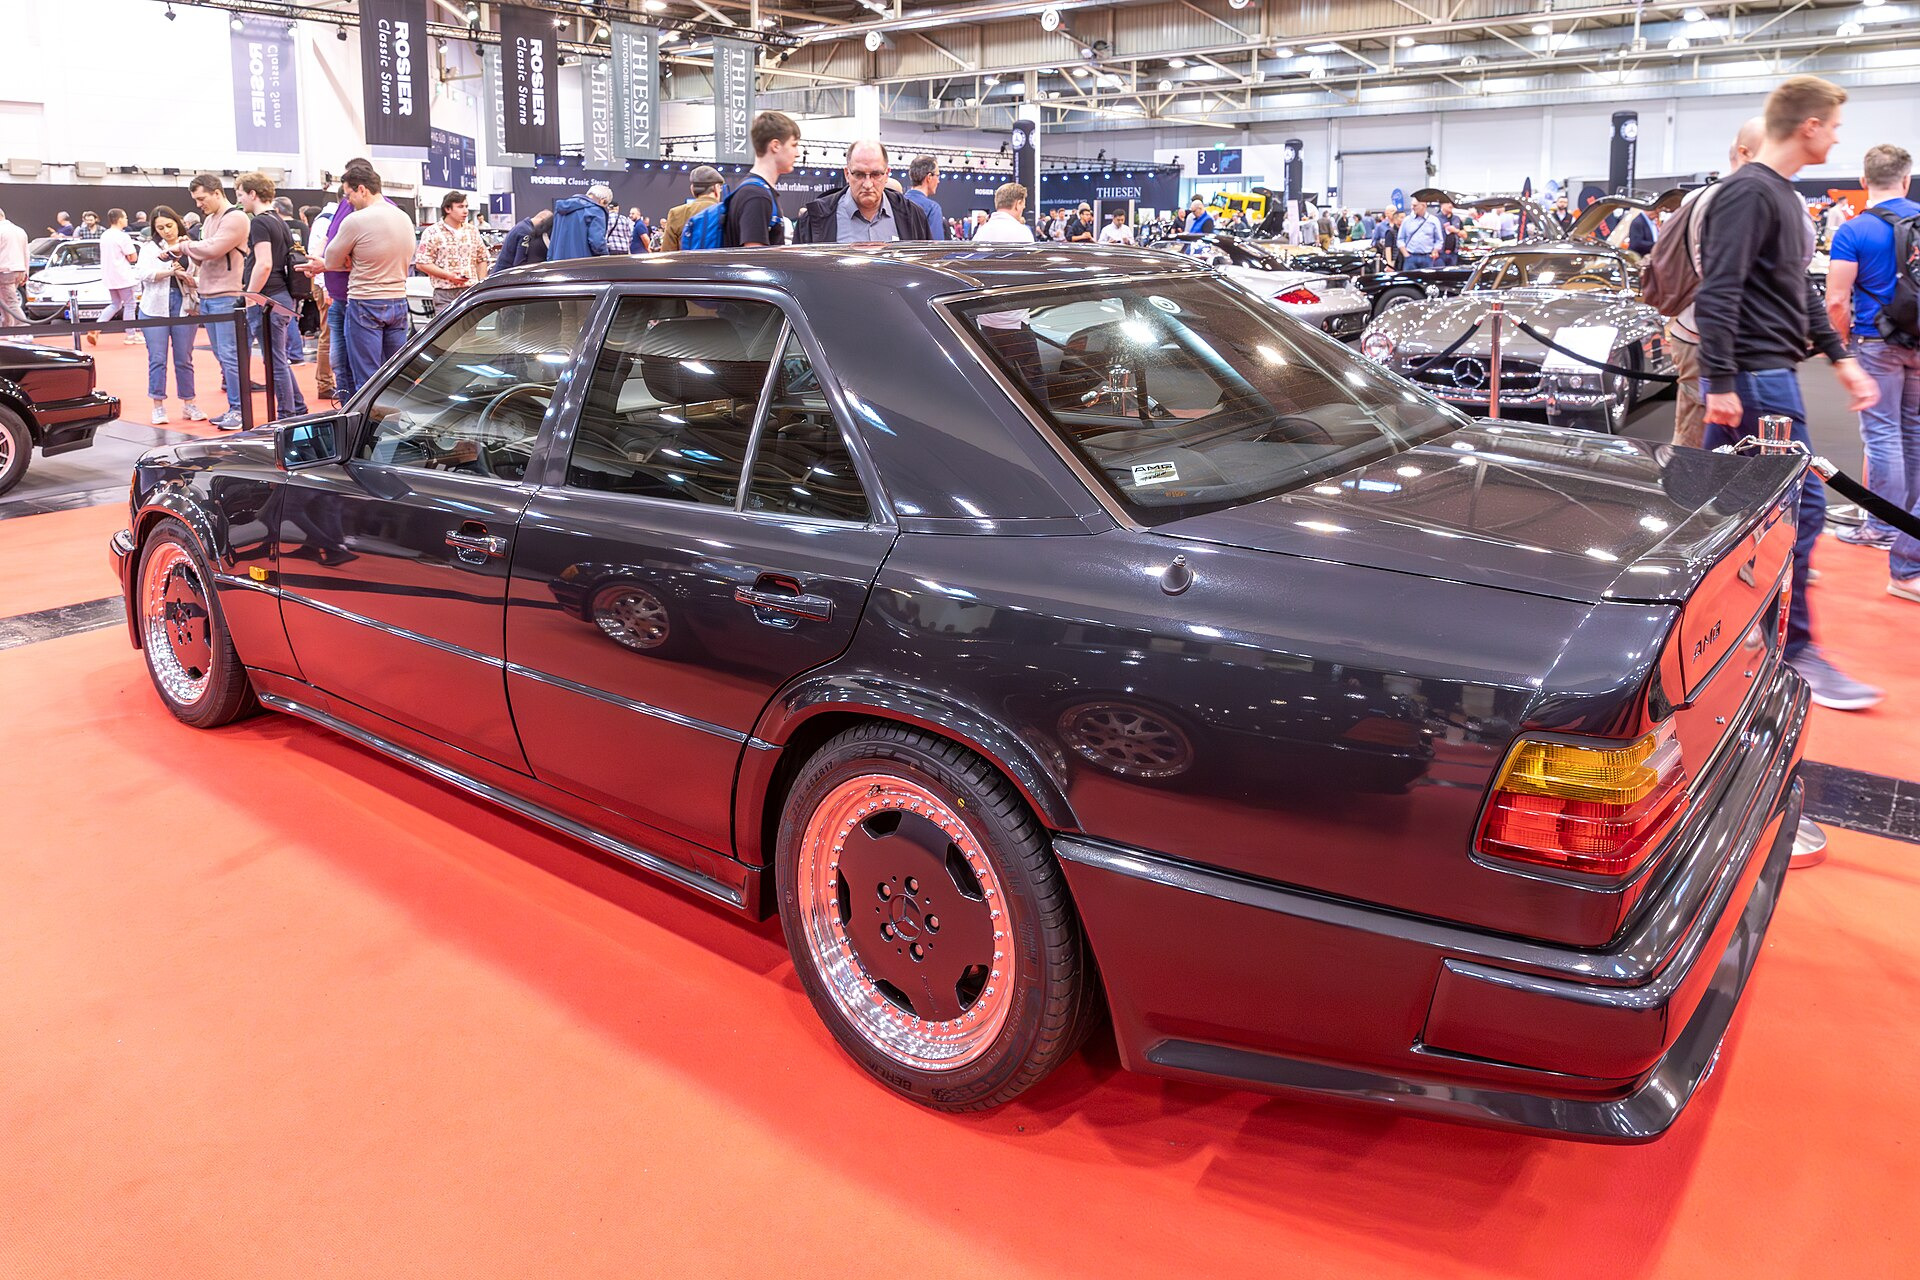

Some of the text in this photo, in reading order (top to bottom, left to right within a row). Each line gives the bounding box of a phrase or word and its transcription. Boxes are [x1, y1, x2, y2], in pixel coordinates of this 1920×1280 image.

[378, 19, 393, 115] Classic Sterne
[395, 21, 412, 116] ROSIER
[516, 36, 529, 126] Classic Sterne
[530, 38, 545, 126] ROSIER
[621, 33, 630, 96] AUTOMOBILE
[632, 35, 649, 149] THIESEN
[722, 47, 730, 105] AUTOMOBILE
[731, 49, 747, 155] THIESEN
[530, 175, 567, 185] ROSIER
[567, 177, 590, 186] Classic
[1198, 151, 1206, 165] 3
[496, 196, 504, 212] 1
[1096, 186, 1142, 198] THIESEN
[1692, 619, 1722, 664] AMG
